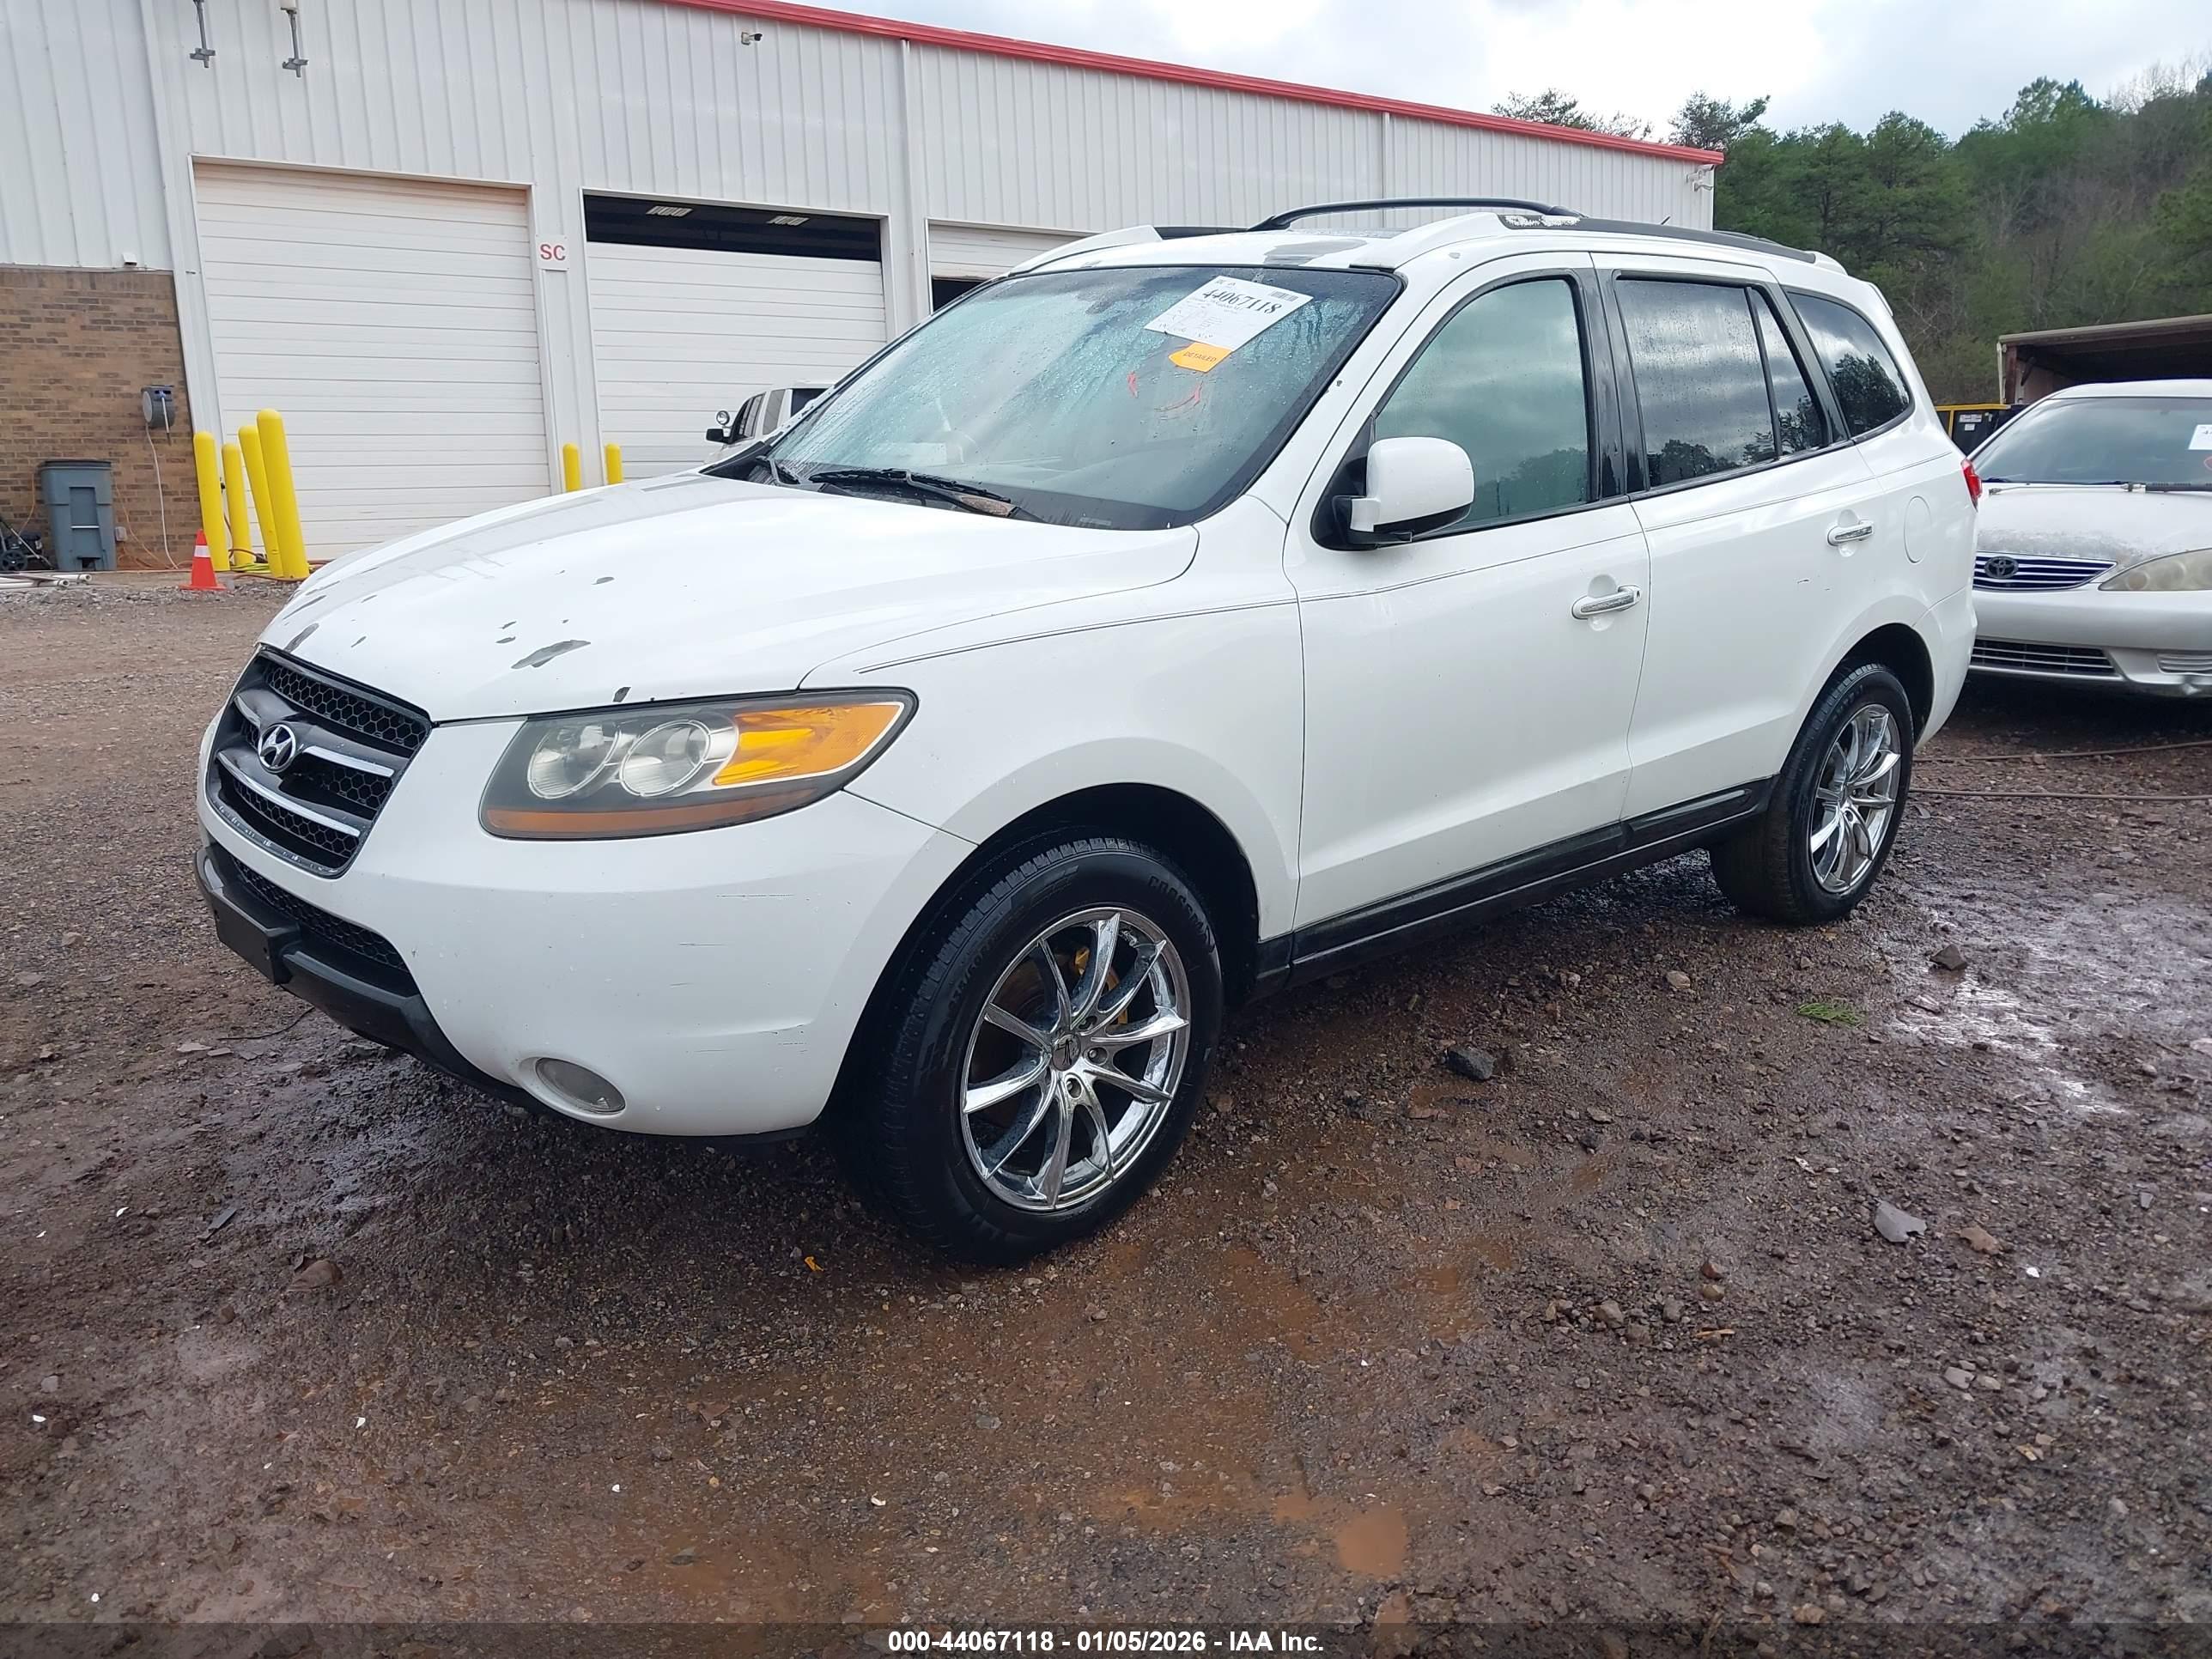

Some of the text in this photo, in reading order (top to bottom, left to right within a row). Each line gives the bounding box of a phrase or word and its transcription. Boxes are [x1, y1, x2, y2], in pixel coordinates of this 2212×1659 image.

[539, 243, 566, 261] SC
[1201, 288, 1283, 314] 44067118
[1182, 350, 1218, 362] DETAILED
